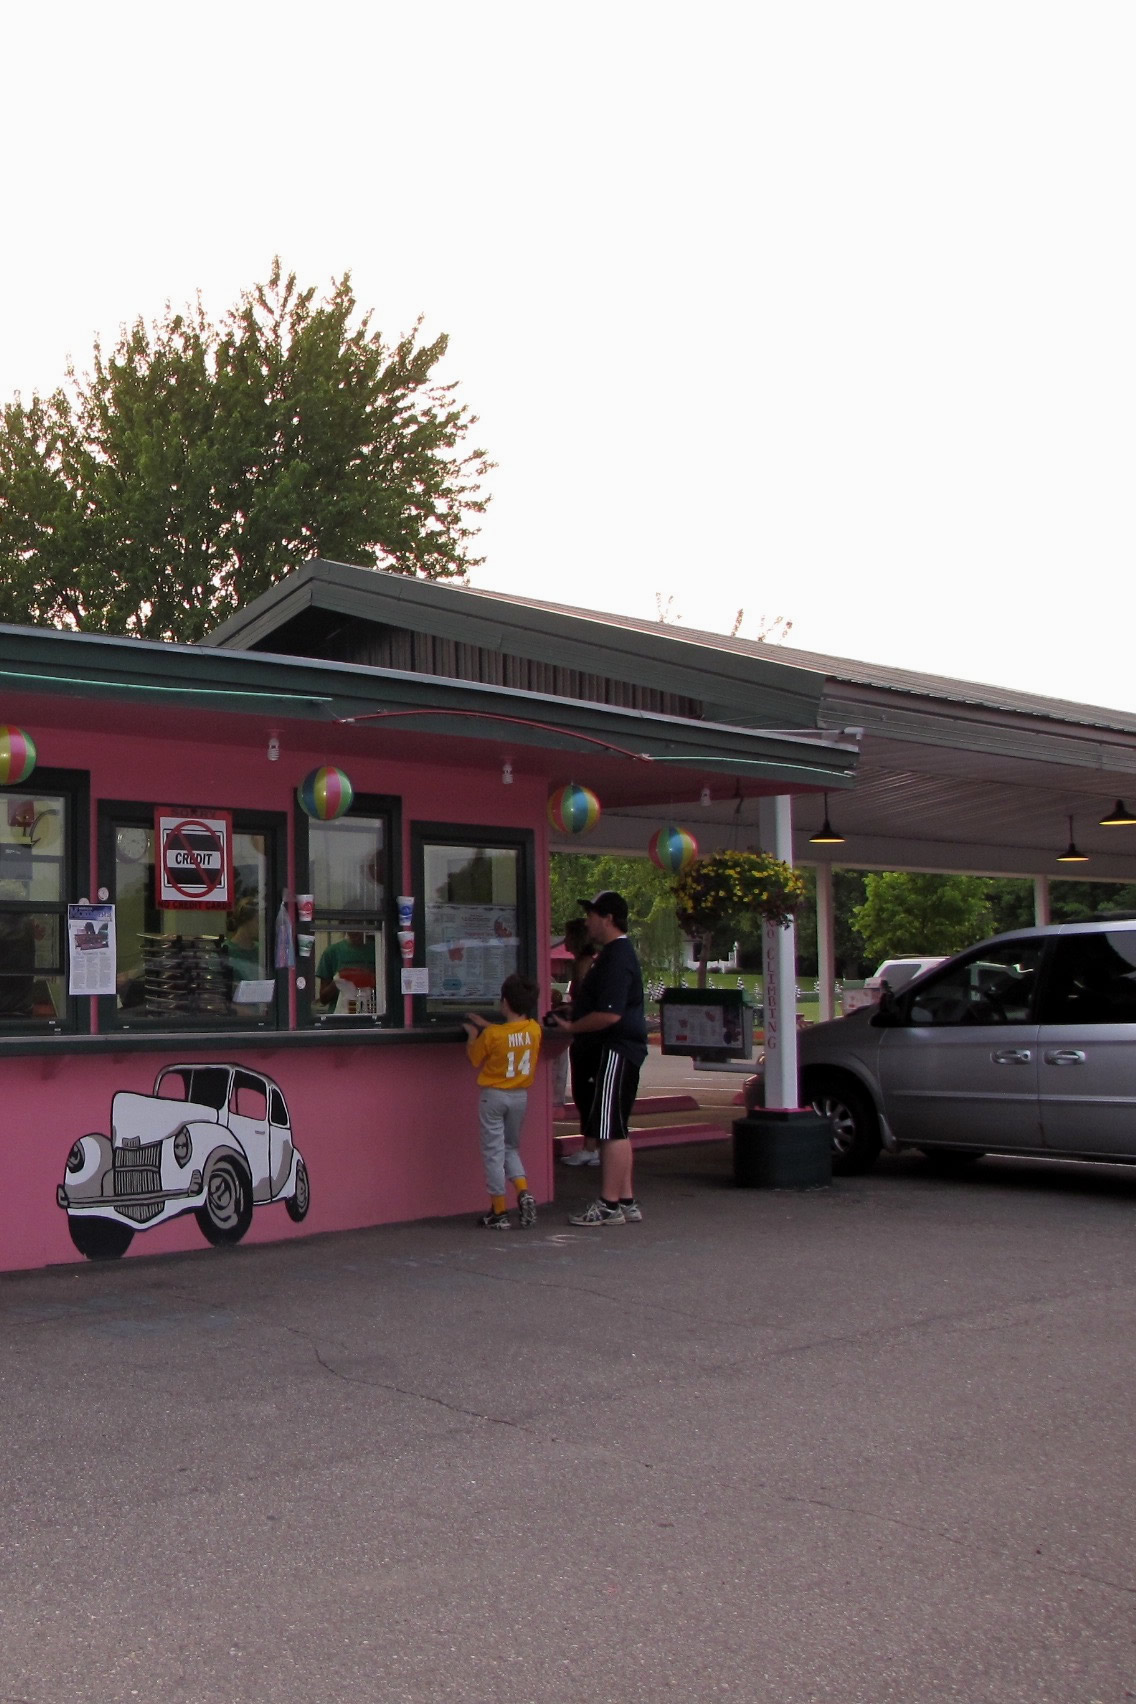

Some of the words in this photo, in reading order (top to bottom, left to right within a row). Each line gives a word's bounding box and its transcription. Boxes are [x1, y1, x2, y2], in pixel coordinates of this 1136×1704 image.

[175, 852, 213, 866] CREDIT
[767, 949, 777, 1050] CLIMBING
[508, 1031, 531, 1048] MIKA
[506, 1049, 531, 1078] 14
